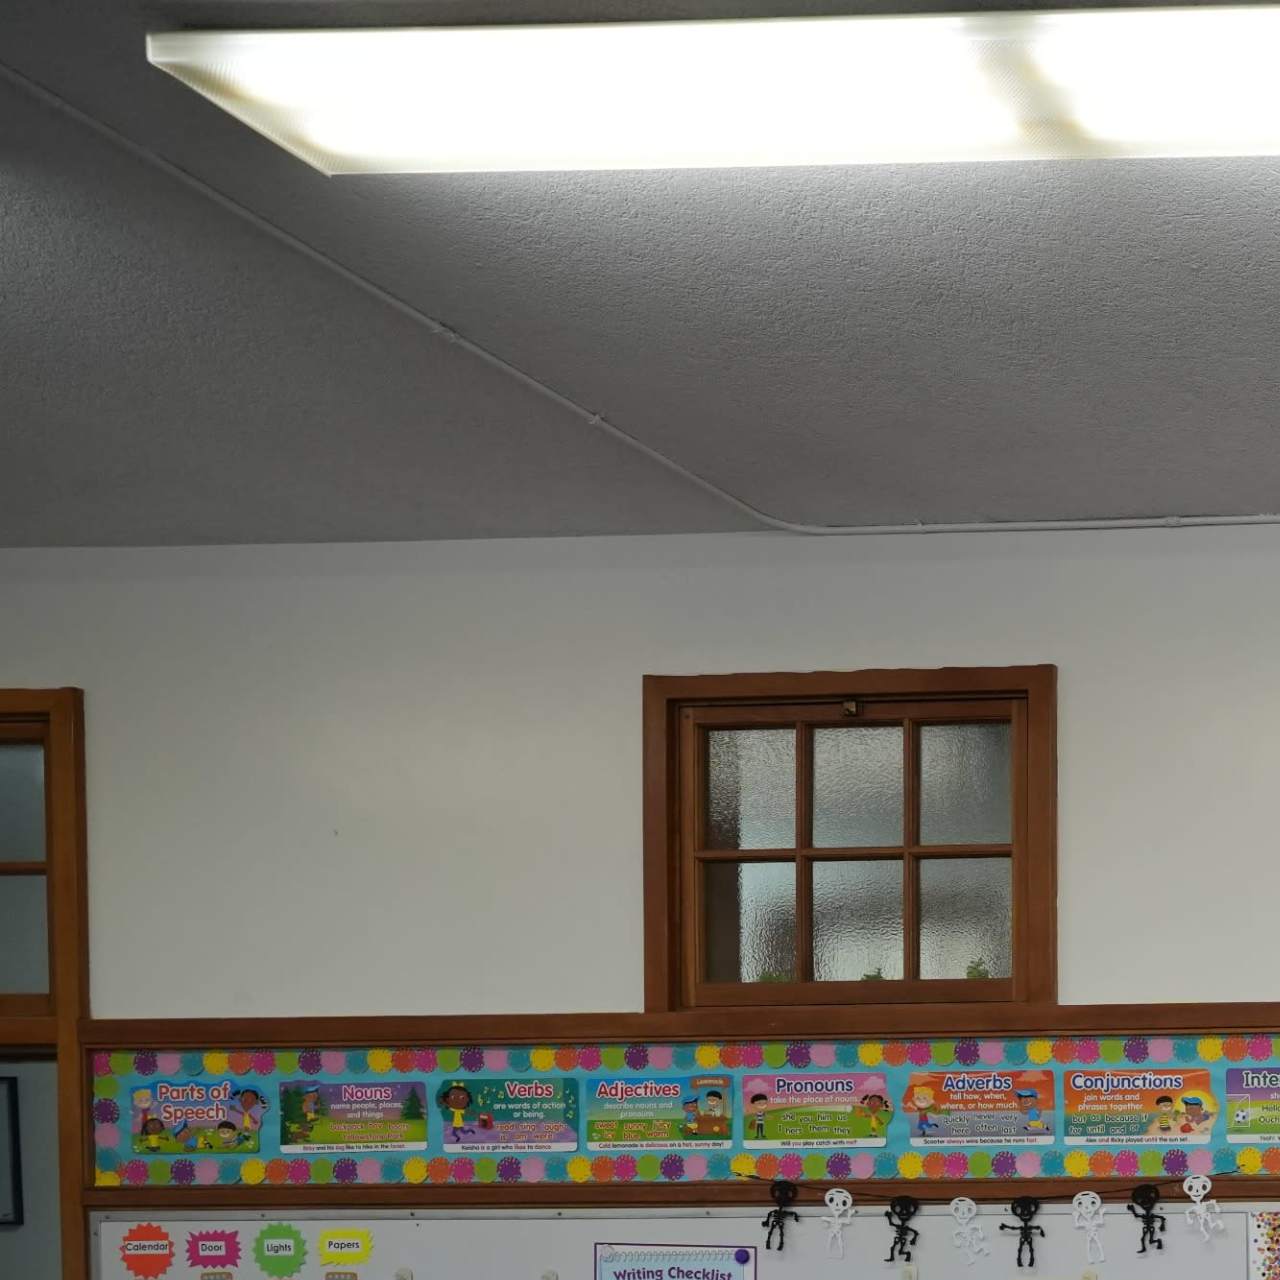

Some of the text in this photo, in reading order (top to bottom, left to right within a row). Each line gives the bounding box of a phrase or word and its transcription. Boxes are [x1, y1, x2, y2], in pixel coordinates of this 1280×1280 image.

[505, 1080, 553, 1098] Verbs
[776, 1078, 854, 1094] Pronouns
[943, 1073, 1012, 1091] Adverbs
[1071, 1071, 1183, 1092] Conjunctions
[158, 1081, 231, 1100] Parts of
[342, 1084, 392, 1100] Nouns
[597, 1080, 680, 1102] Adjectives
[1100, 1092, 1123, 1101] words
[1124, 1092, 1140, 1101] and
[162, 1102, 227, 1125] Speech
[508, 1102, 531, 1110] words
[977, 1102, 995, 1110] how
[125, 1241, 168, 1252] Calendar
[200, 1243, 223, 1252] Door
[265, 1243, 292, 1254] Lights
[328, 1241, 360, 1252] Papers
